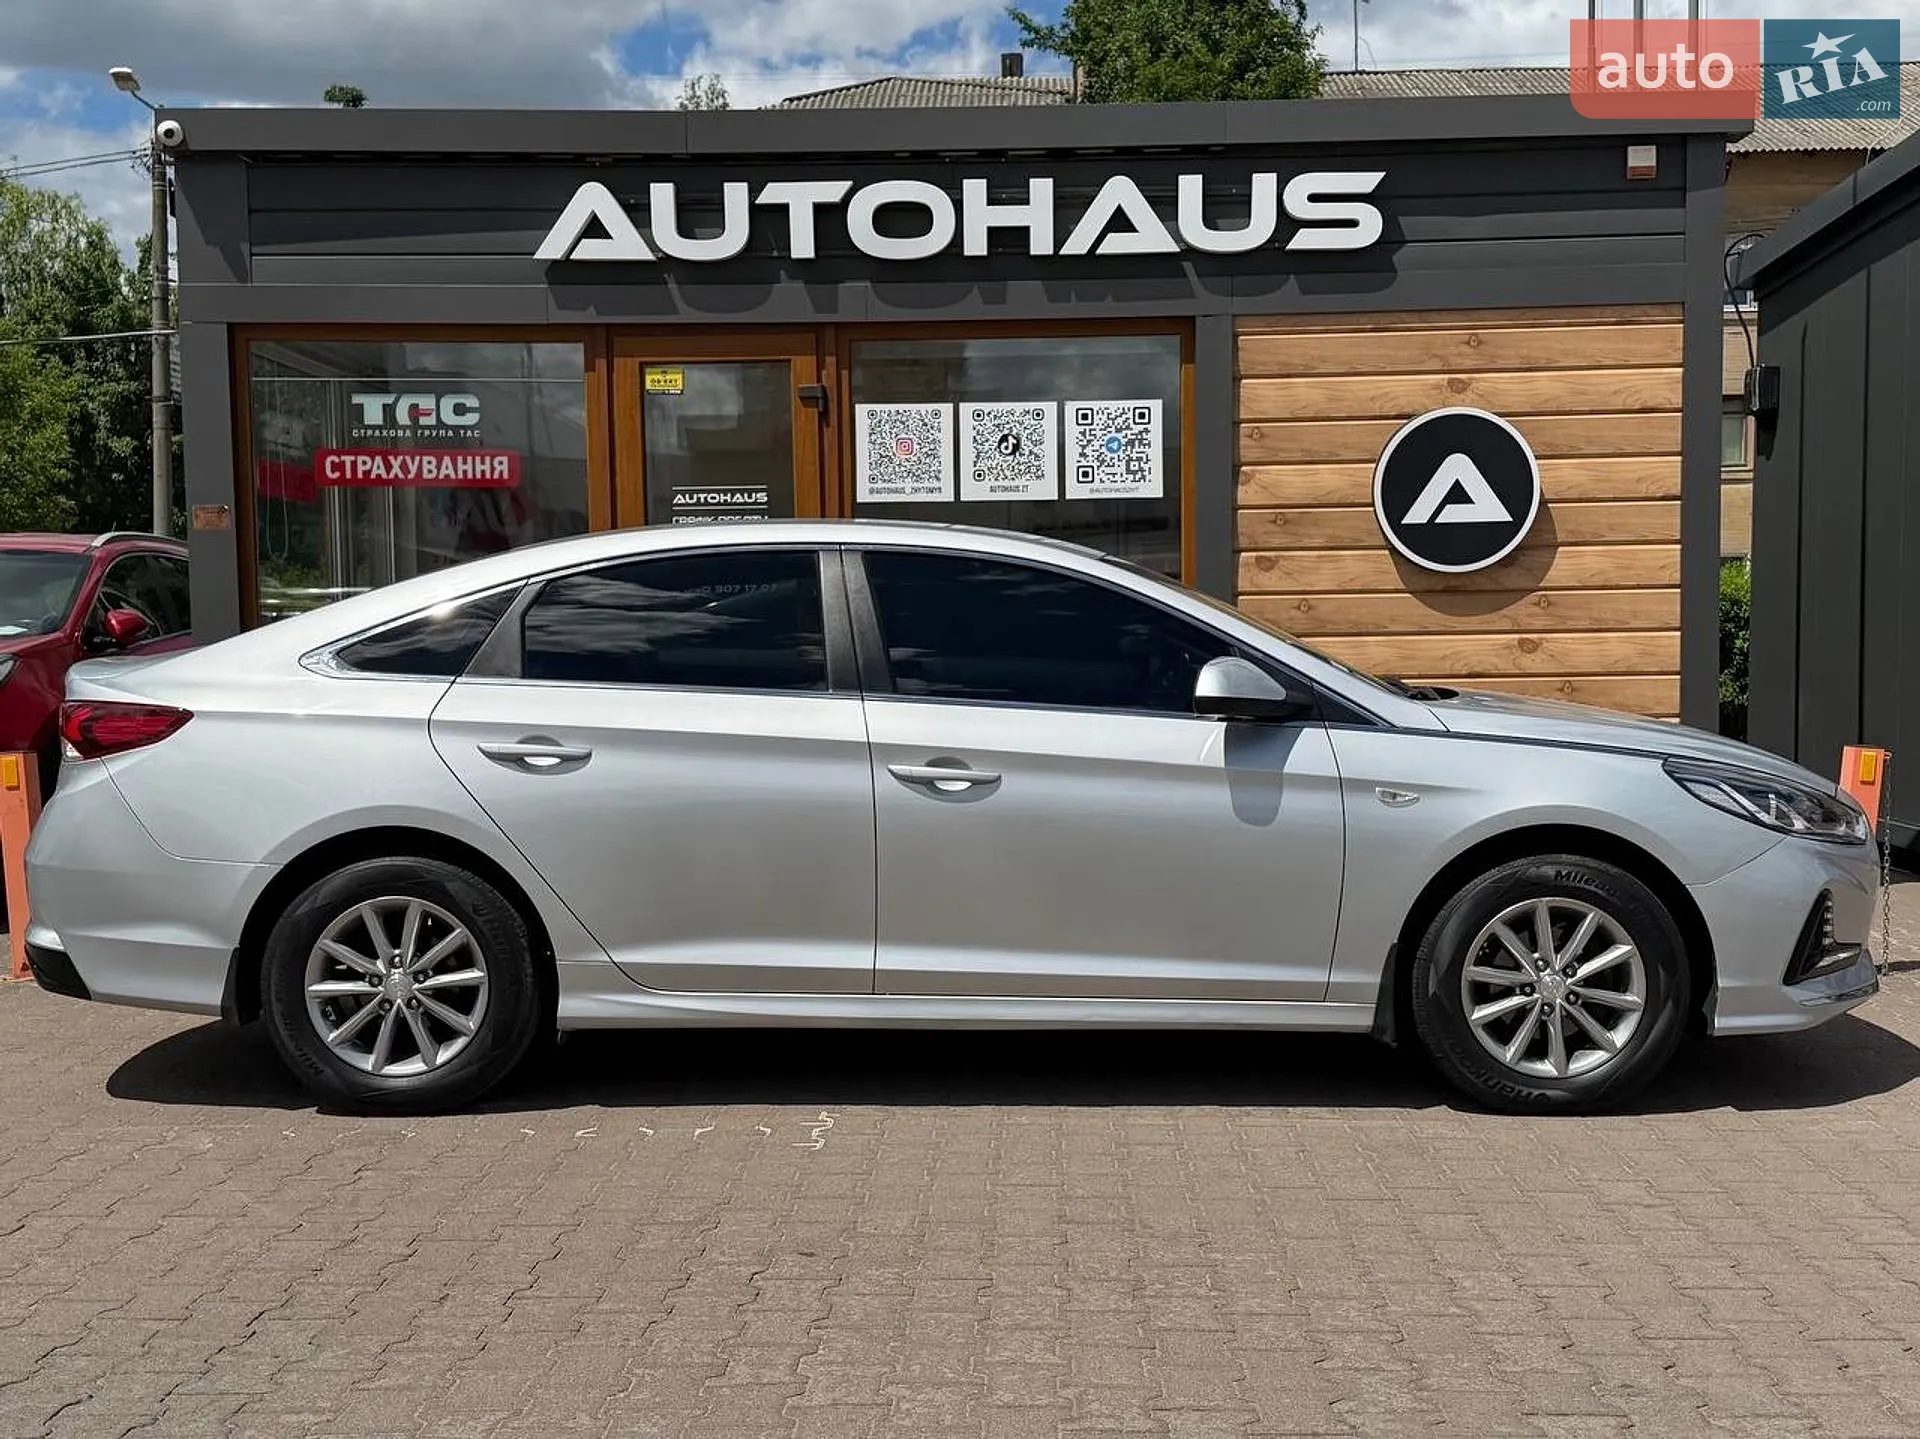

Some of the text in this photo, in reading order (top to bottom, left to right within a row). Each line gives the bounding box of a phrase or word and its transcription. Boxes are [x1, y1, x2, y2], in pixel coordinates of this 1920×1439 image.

[533, 170, 1387, 262] AUTOHAUS
[352, 428, 481, 438] СТРАХОВА ГРУПА ТАС
[325, 454, 509, 480] СТРАХУВАННЯ
[672, 492, 768, 504] AUTOHAUS
